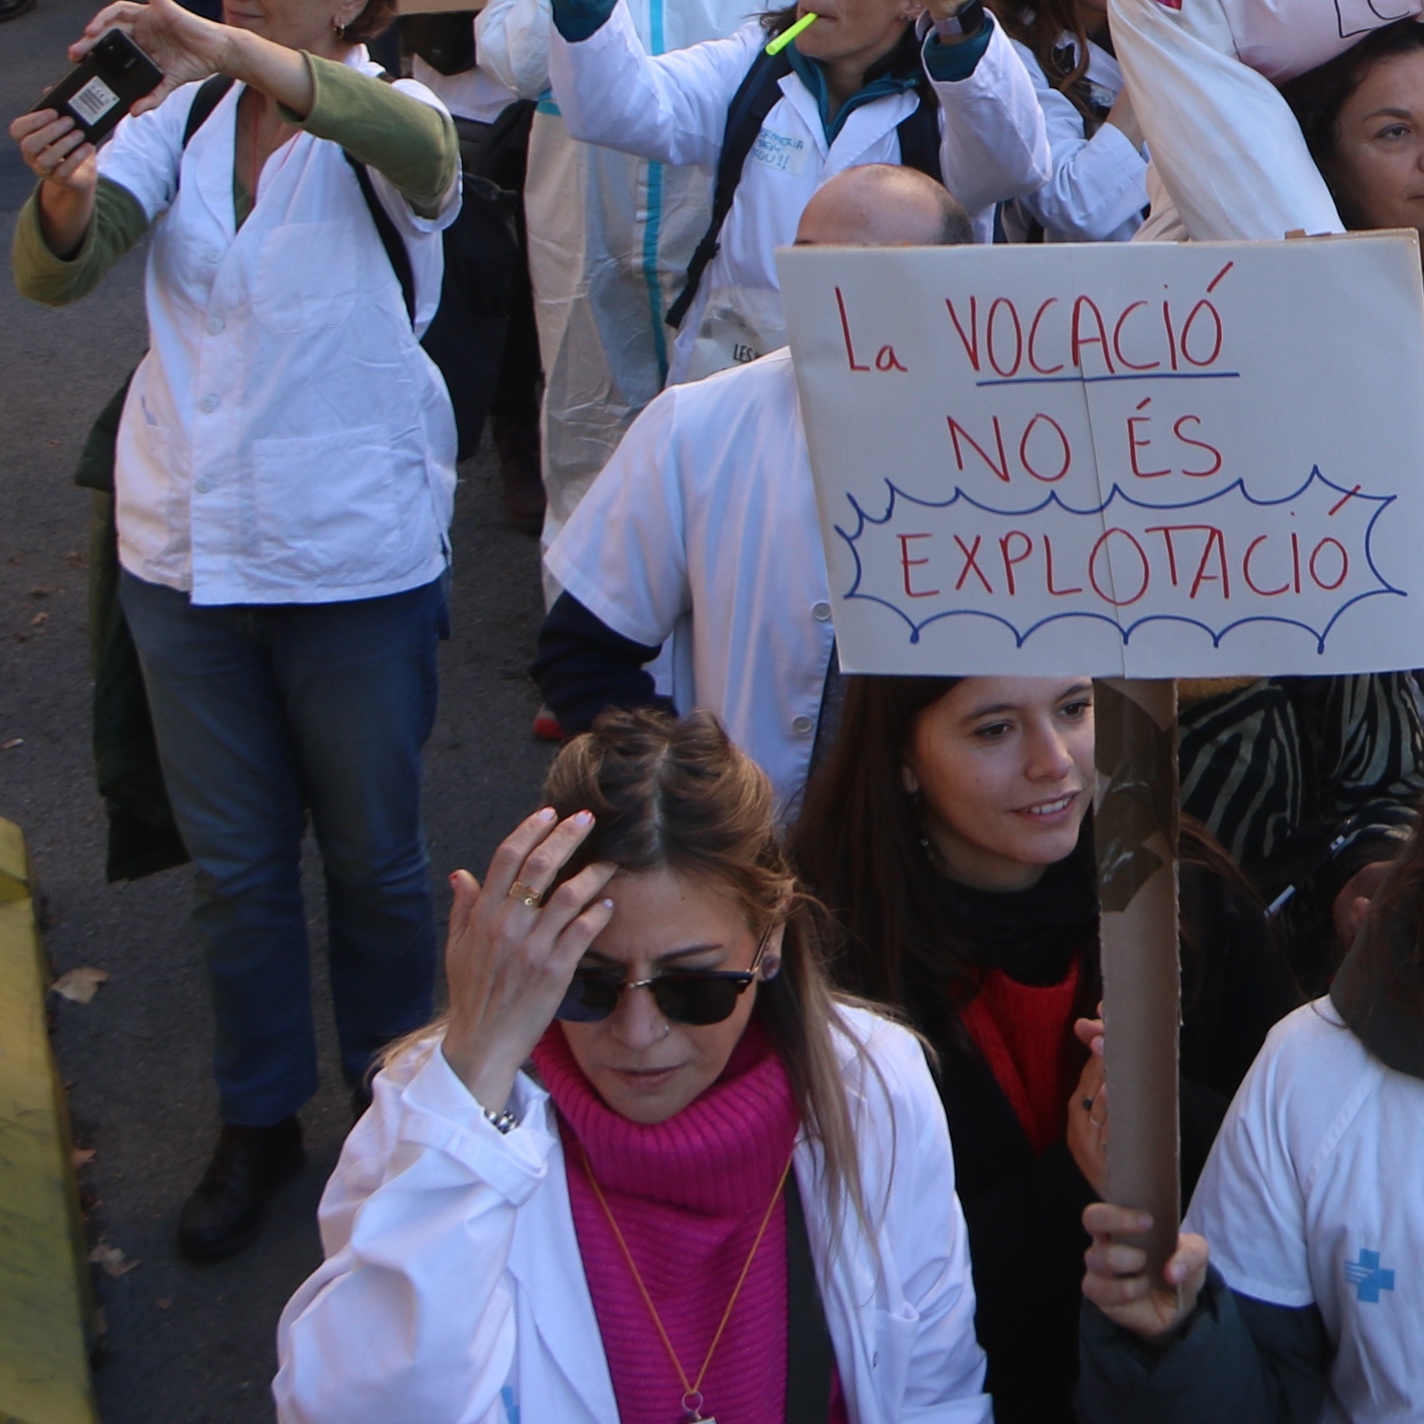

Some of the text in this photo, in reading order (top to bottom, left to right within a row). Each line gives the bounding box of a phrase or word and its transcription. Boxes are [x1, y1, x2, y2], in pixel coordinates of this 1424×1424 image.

[834, 286, 908, 373] La
[946, 396, 1223, 484] NO ÉS
